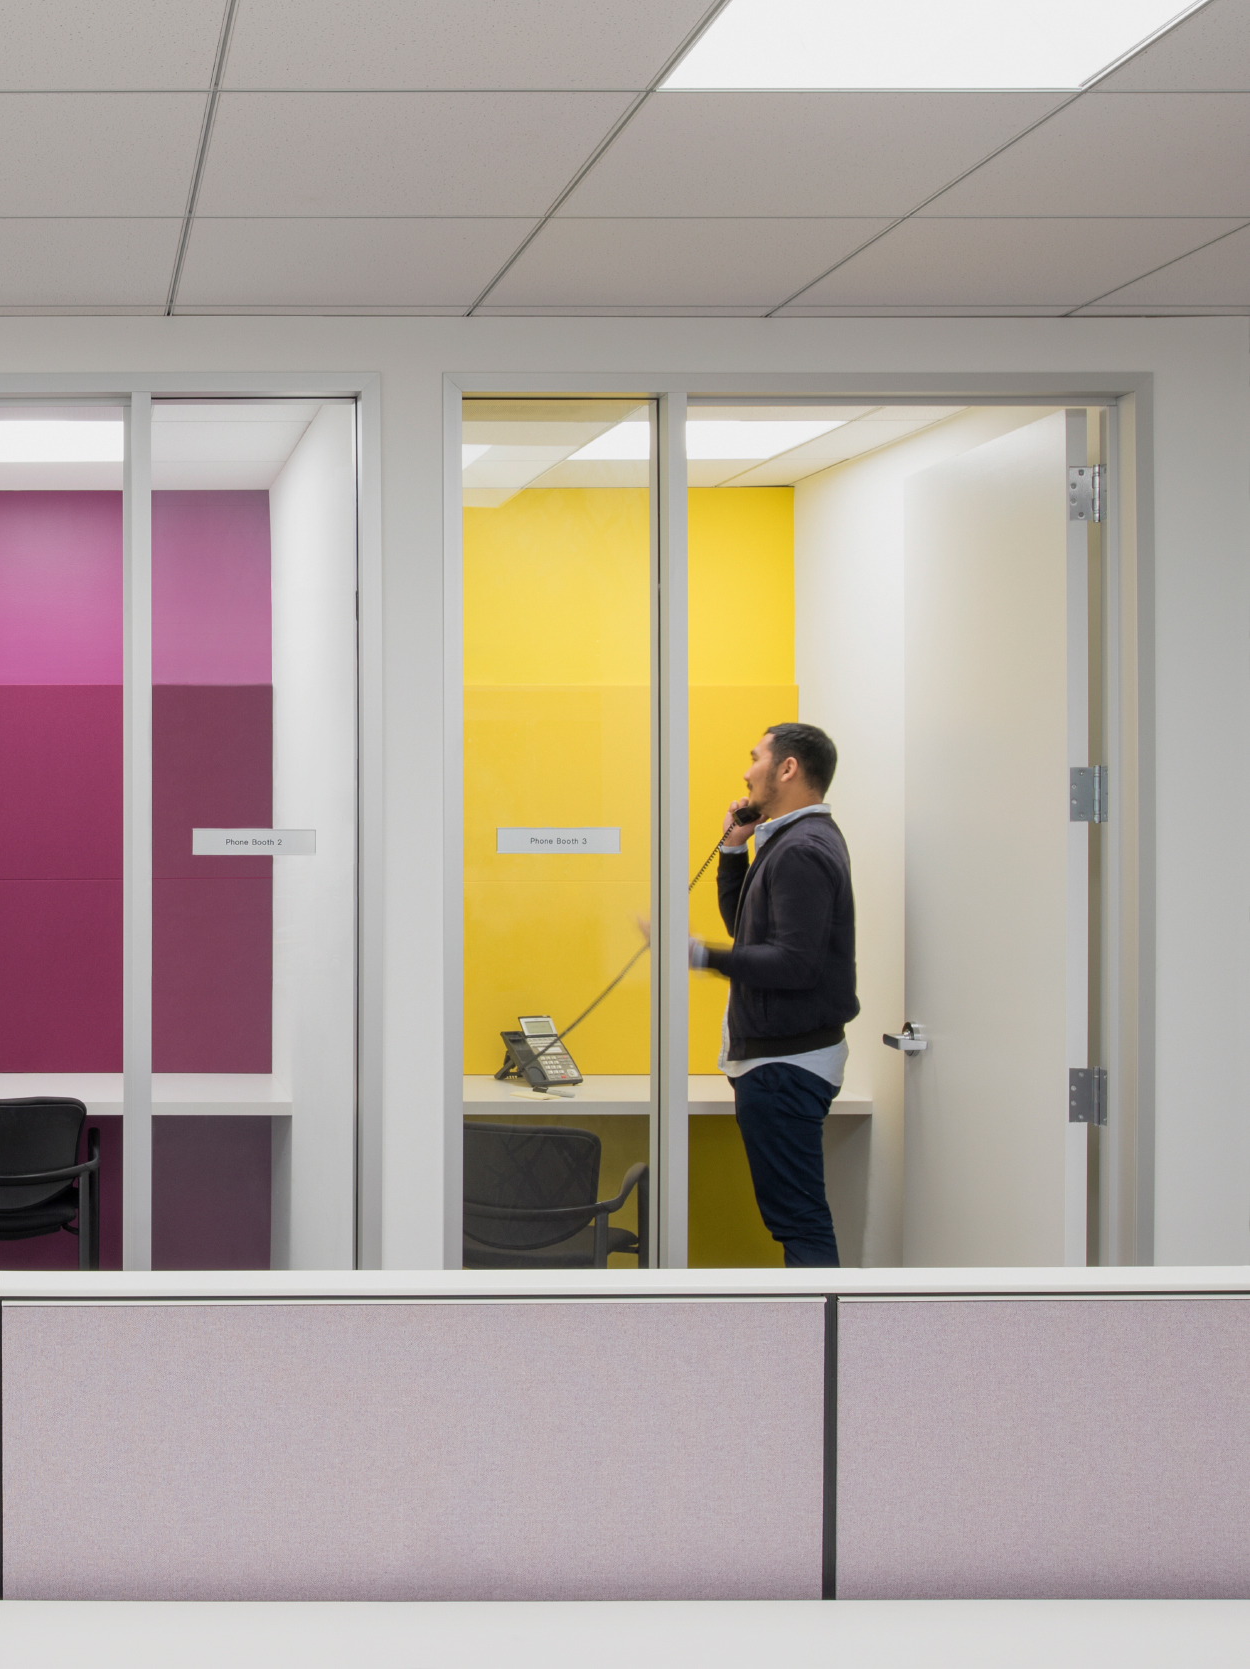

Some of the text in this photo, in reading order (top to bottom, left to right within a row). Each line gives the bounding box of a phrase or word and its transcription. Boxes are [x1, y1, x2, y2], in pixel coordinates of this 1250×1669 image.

[225, 838, 283, 846] Phone Booth 2
[530, 837, 588, 845] Phone Booth 3
